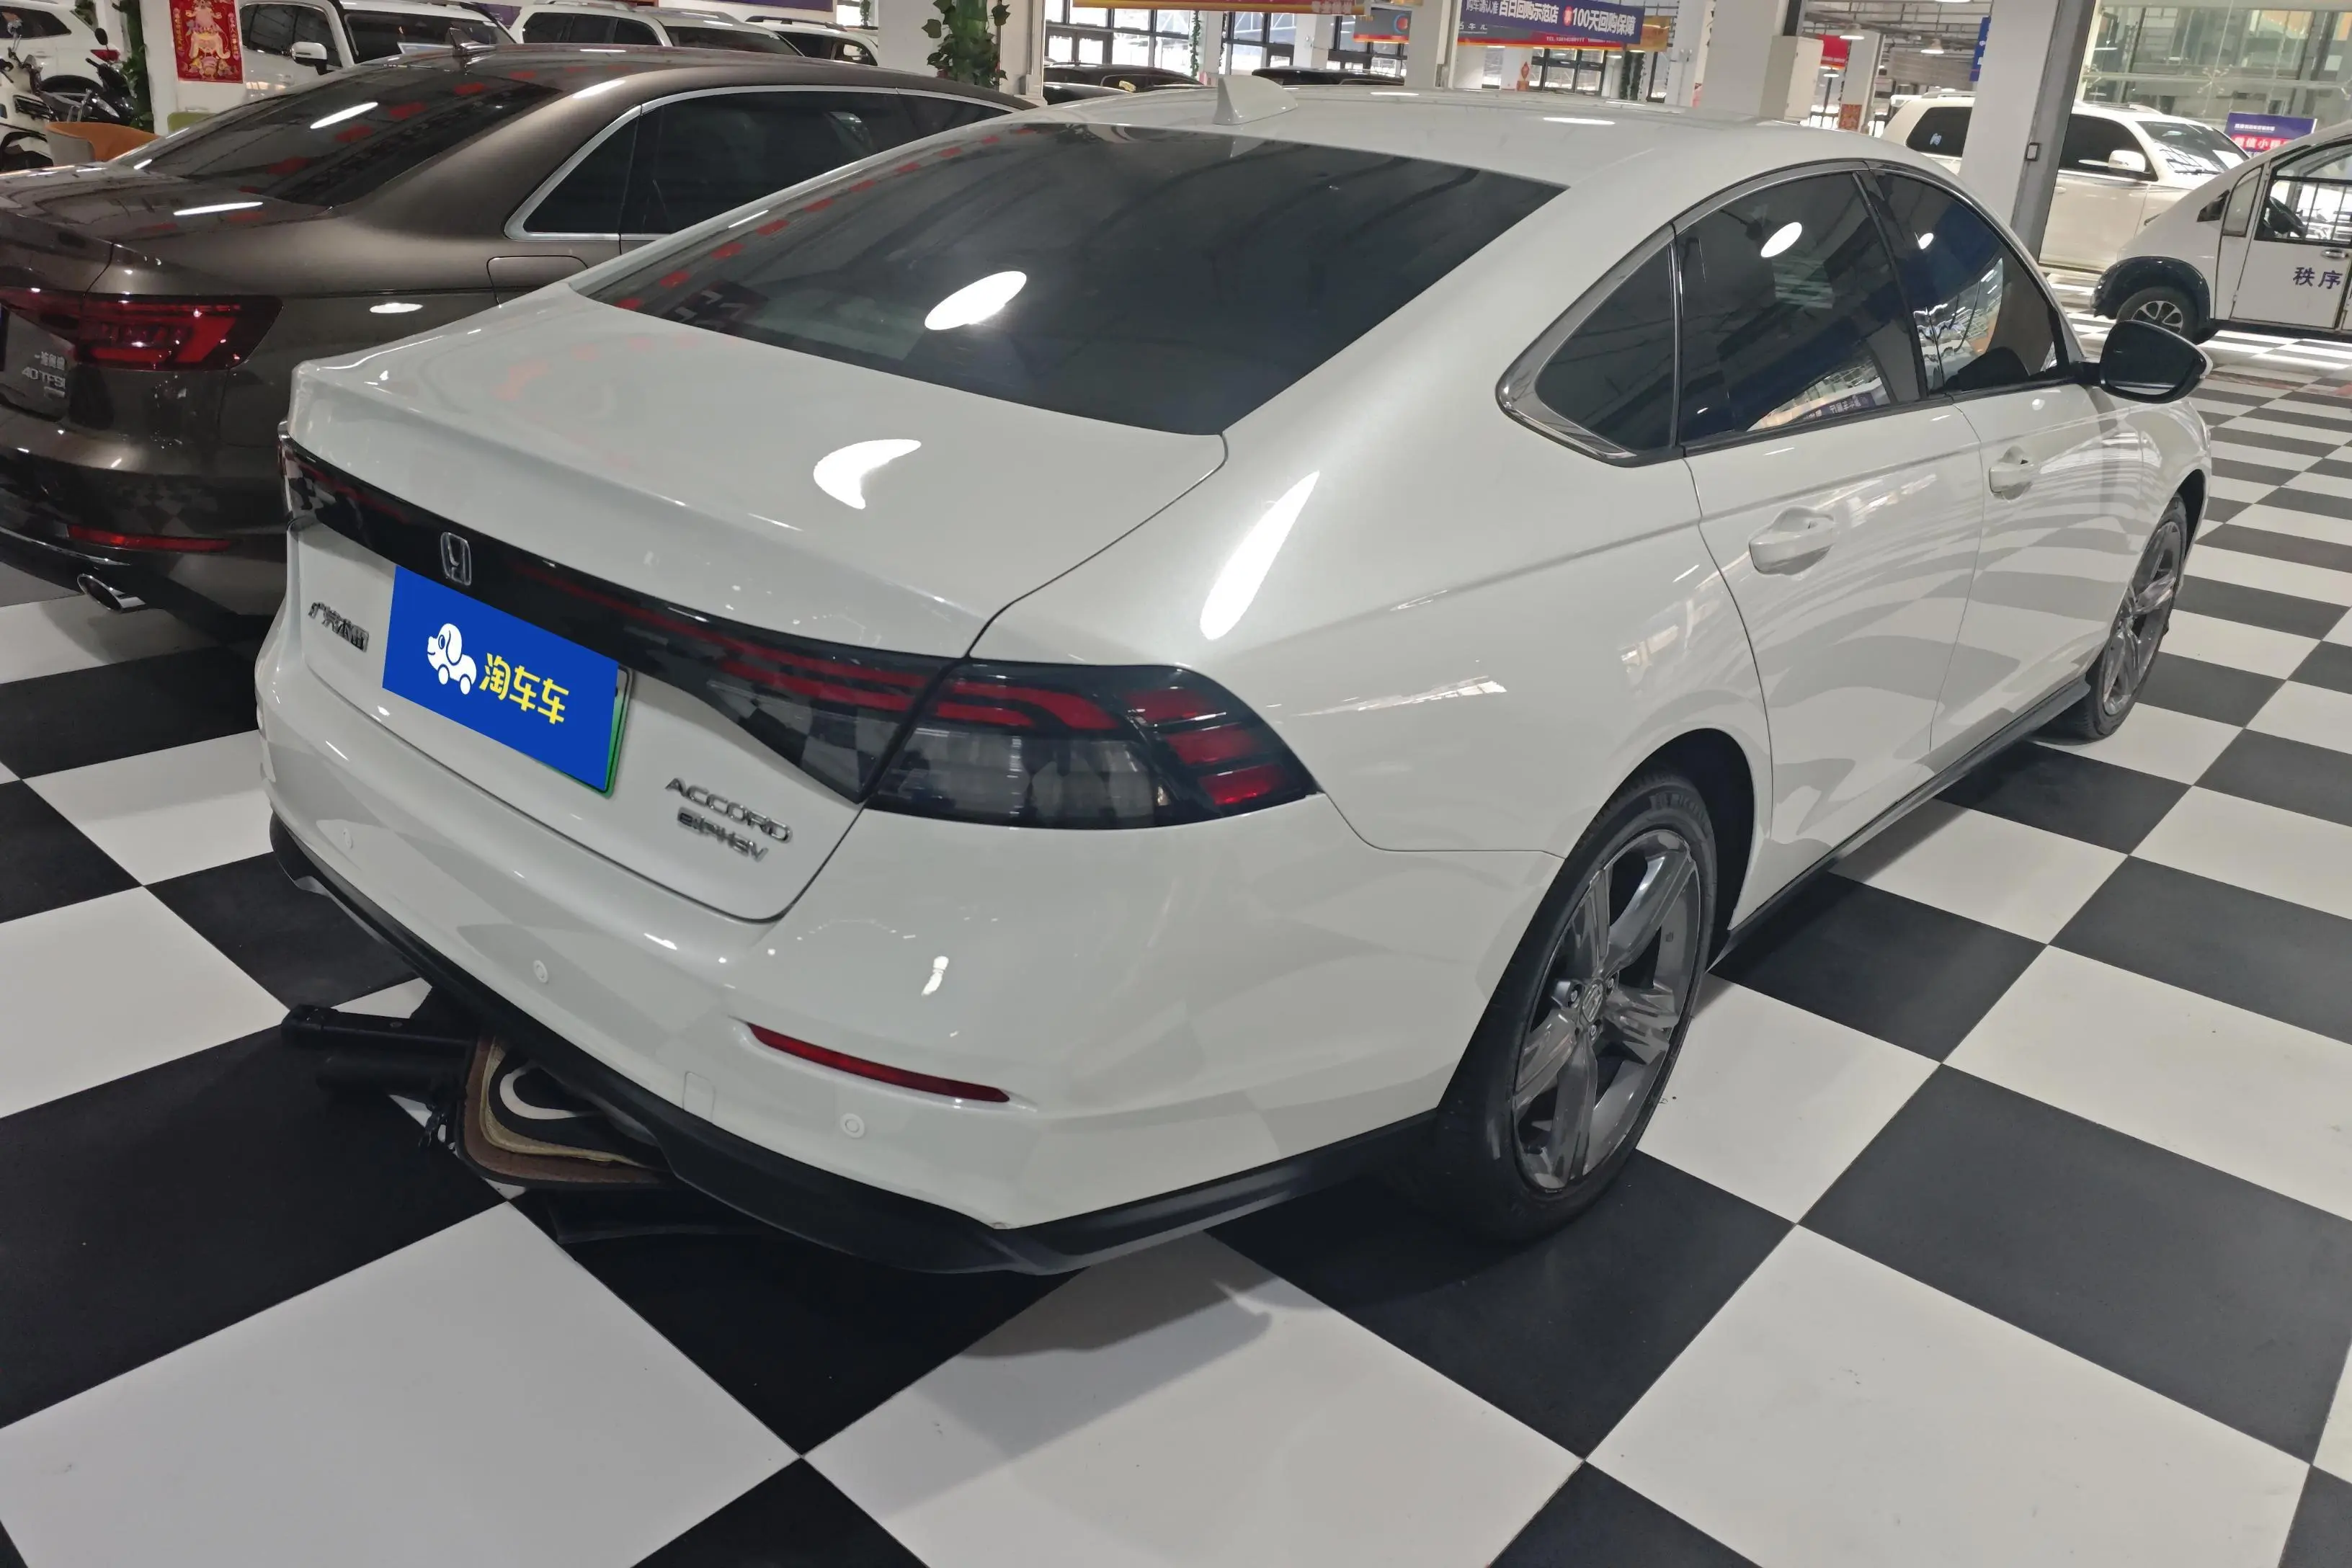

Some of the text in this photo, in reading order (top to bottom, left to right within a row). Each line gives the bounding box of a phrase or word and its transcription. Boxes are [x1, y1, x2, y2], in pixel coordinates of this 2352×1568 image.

[2293, 267, 2343, 290] 秩序
[22, 366, 66, 389] 40 TFSI
[664, 778, 793, 844] ACCORD
